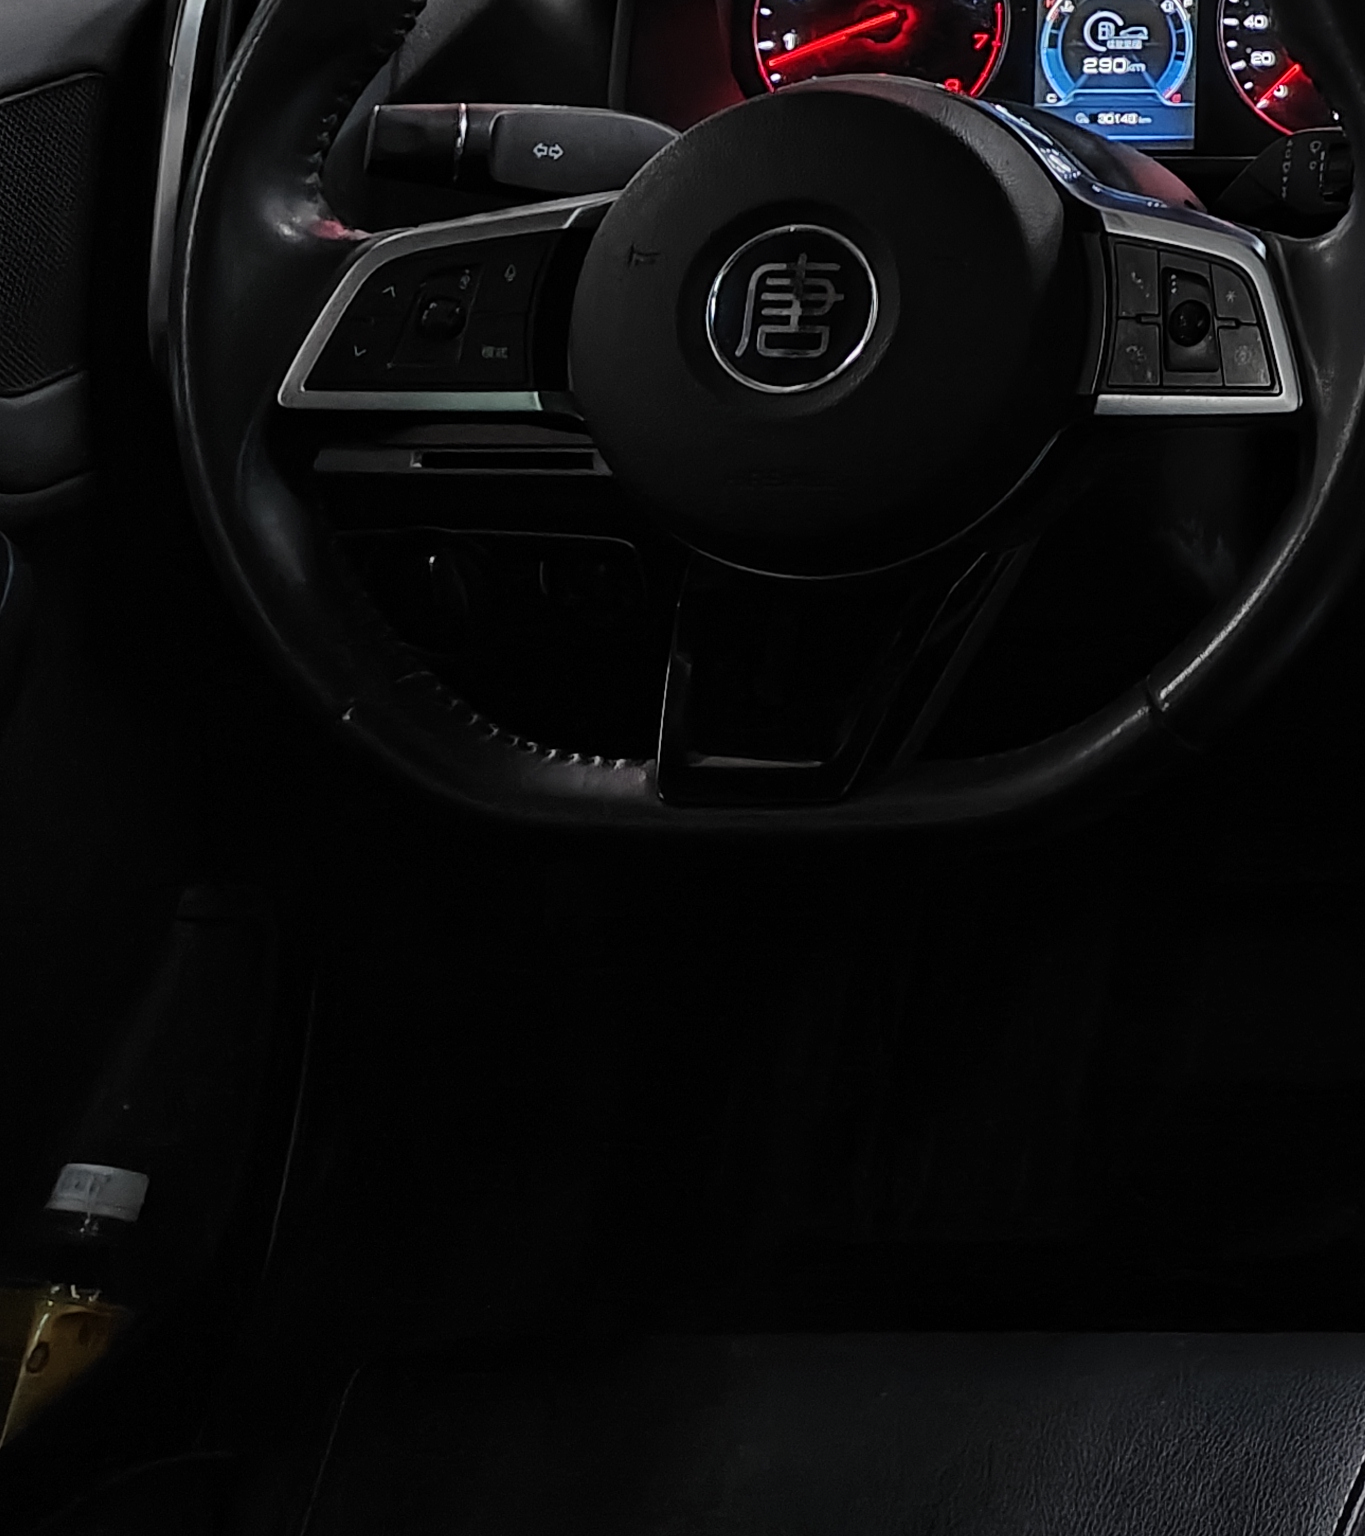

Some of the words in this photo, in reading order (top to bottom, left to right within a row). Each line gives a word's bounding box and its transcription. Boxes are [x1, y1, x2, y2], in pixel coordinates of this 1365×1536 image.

[1243, 14, 1269, 30] 40
[782, 30, 798, 52] 1
[973, 33, 989, 51] 7
[1250, 51, 1276, 67] 20
[736, 253, 844, 360] 唐
